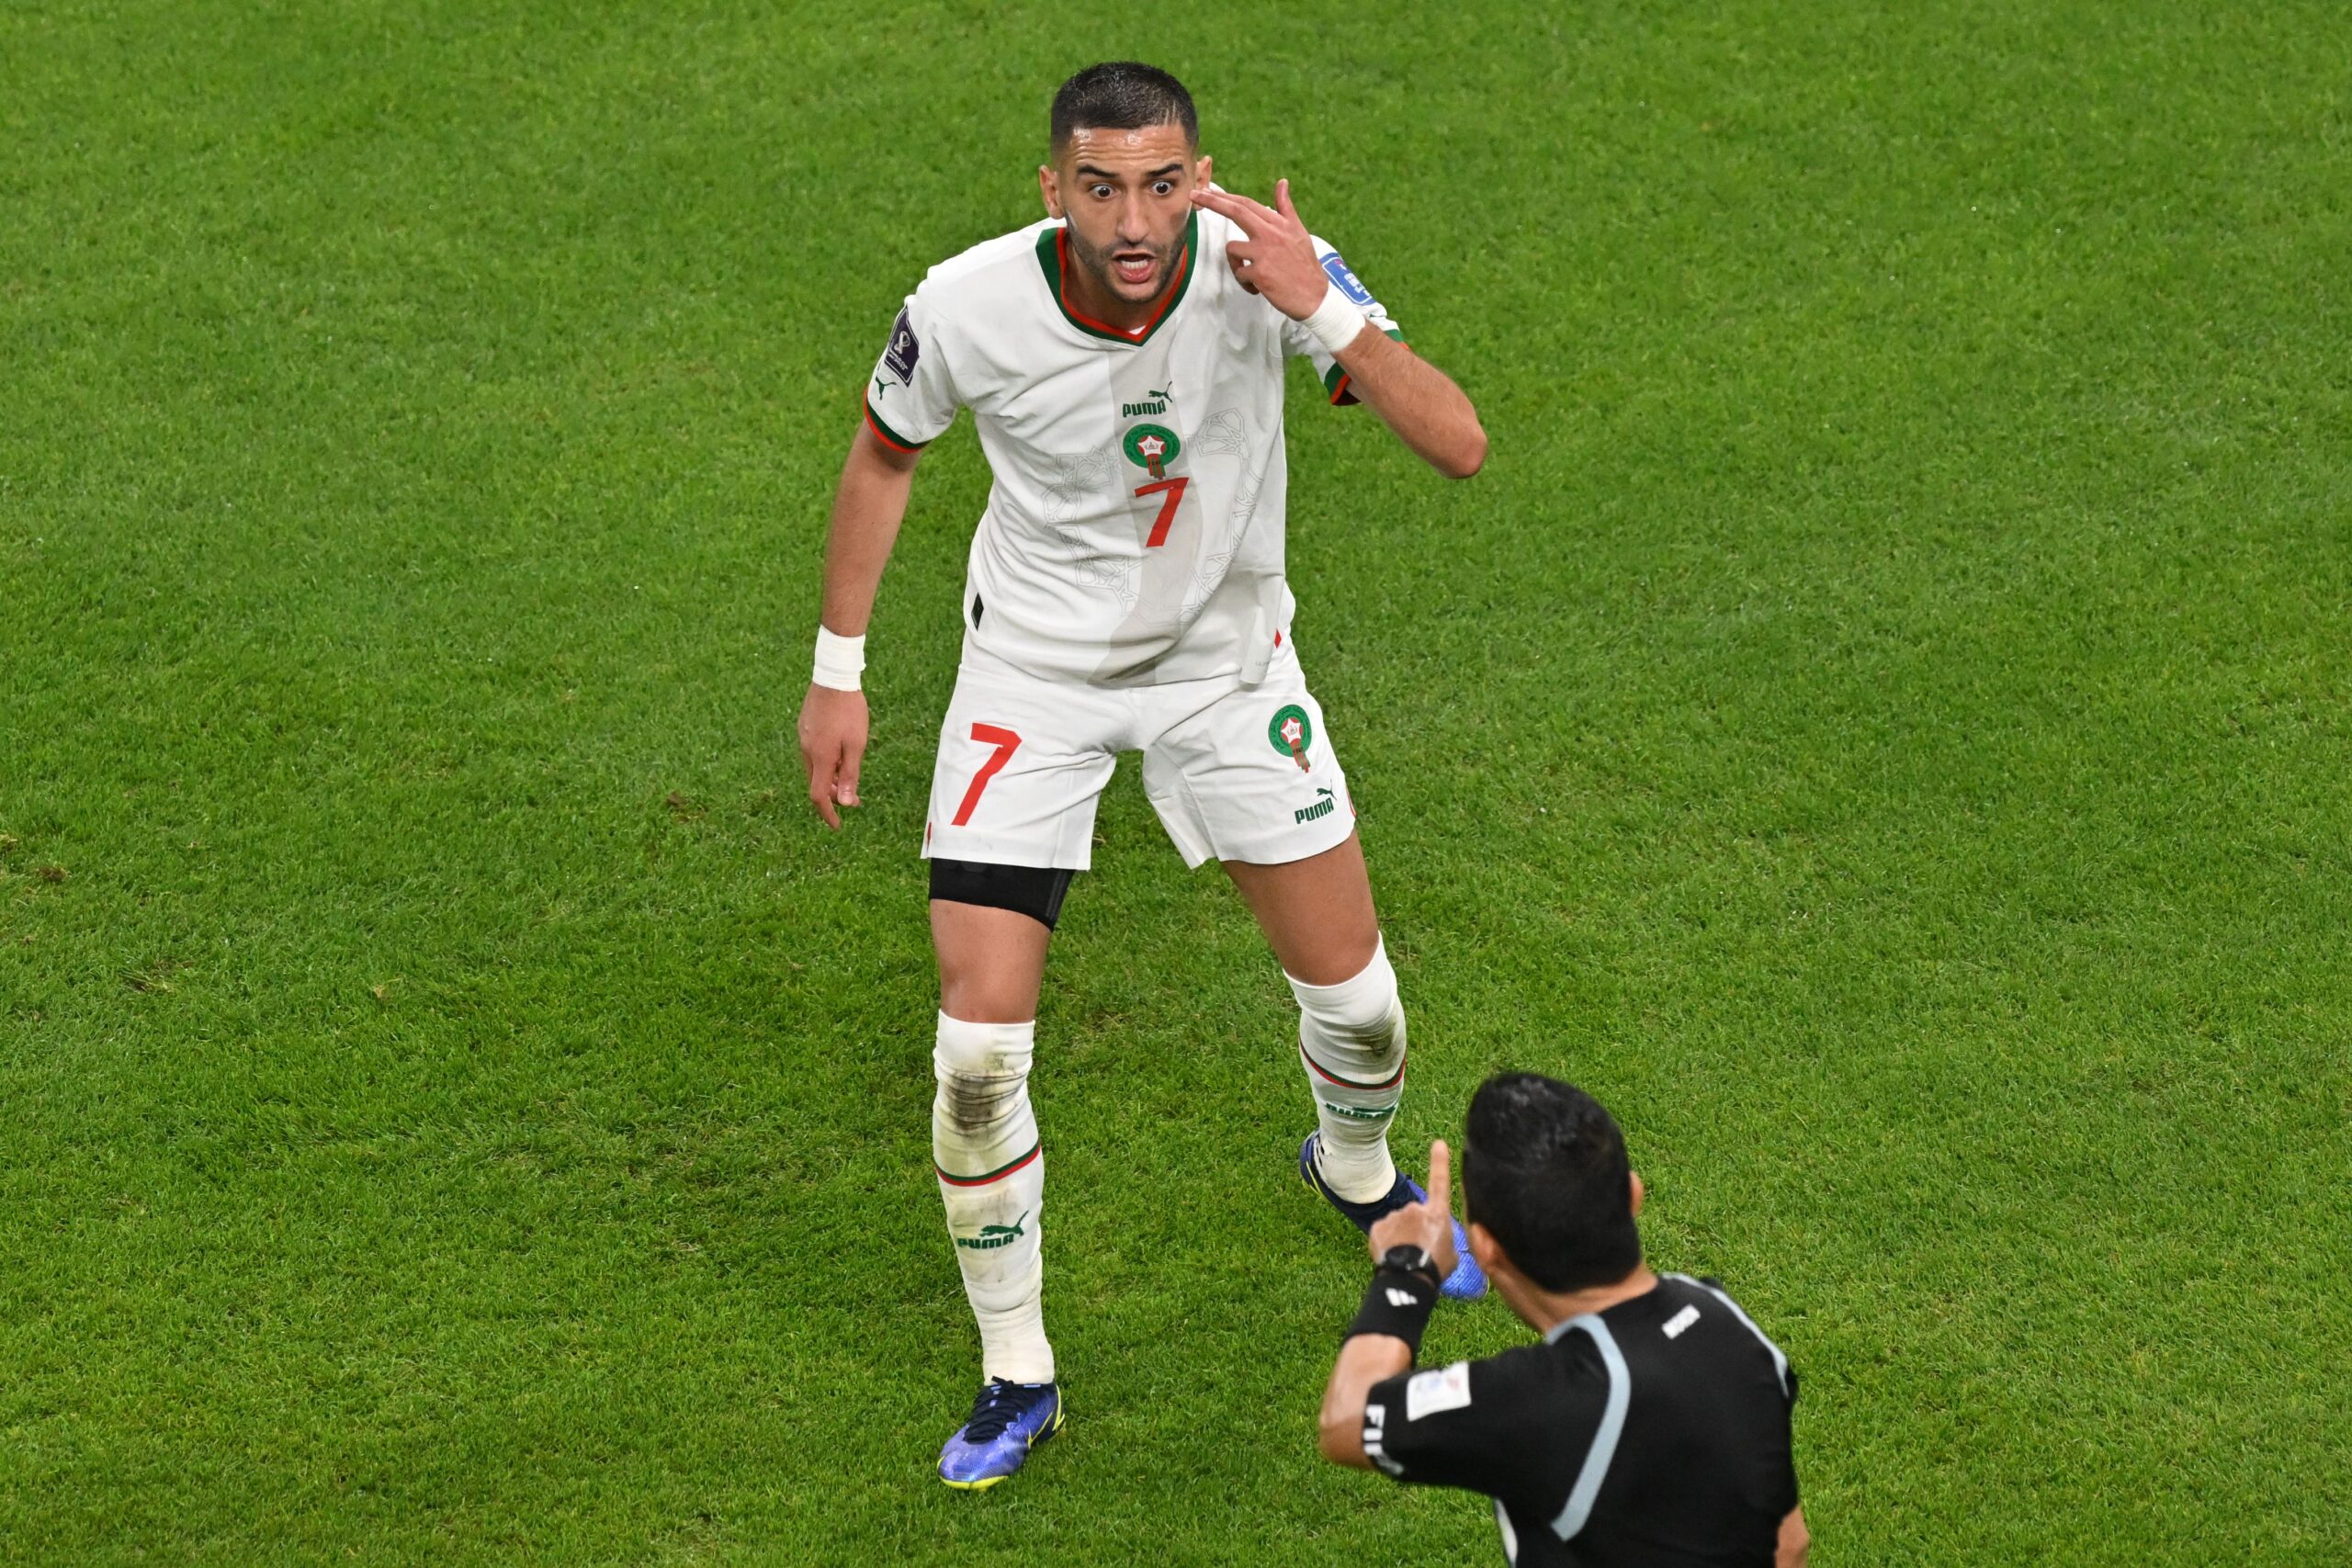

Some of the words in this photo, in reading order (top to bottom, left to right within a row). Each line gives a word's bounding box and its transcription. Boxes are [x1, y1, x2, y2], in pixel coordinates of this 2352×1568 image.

[1122, 399, 1167, 418] PUMA
[1134, 477, 1190, 547] 7
[950, 722, 1023, 827] 7
[1294, 797, 1335, 825] PUMA
[956, 1234, 1014, 1250] PUMA
